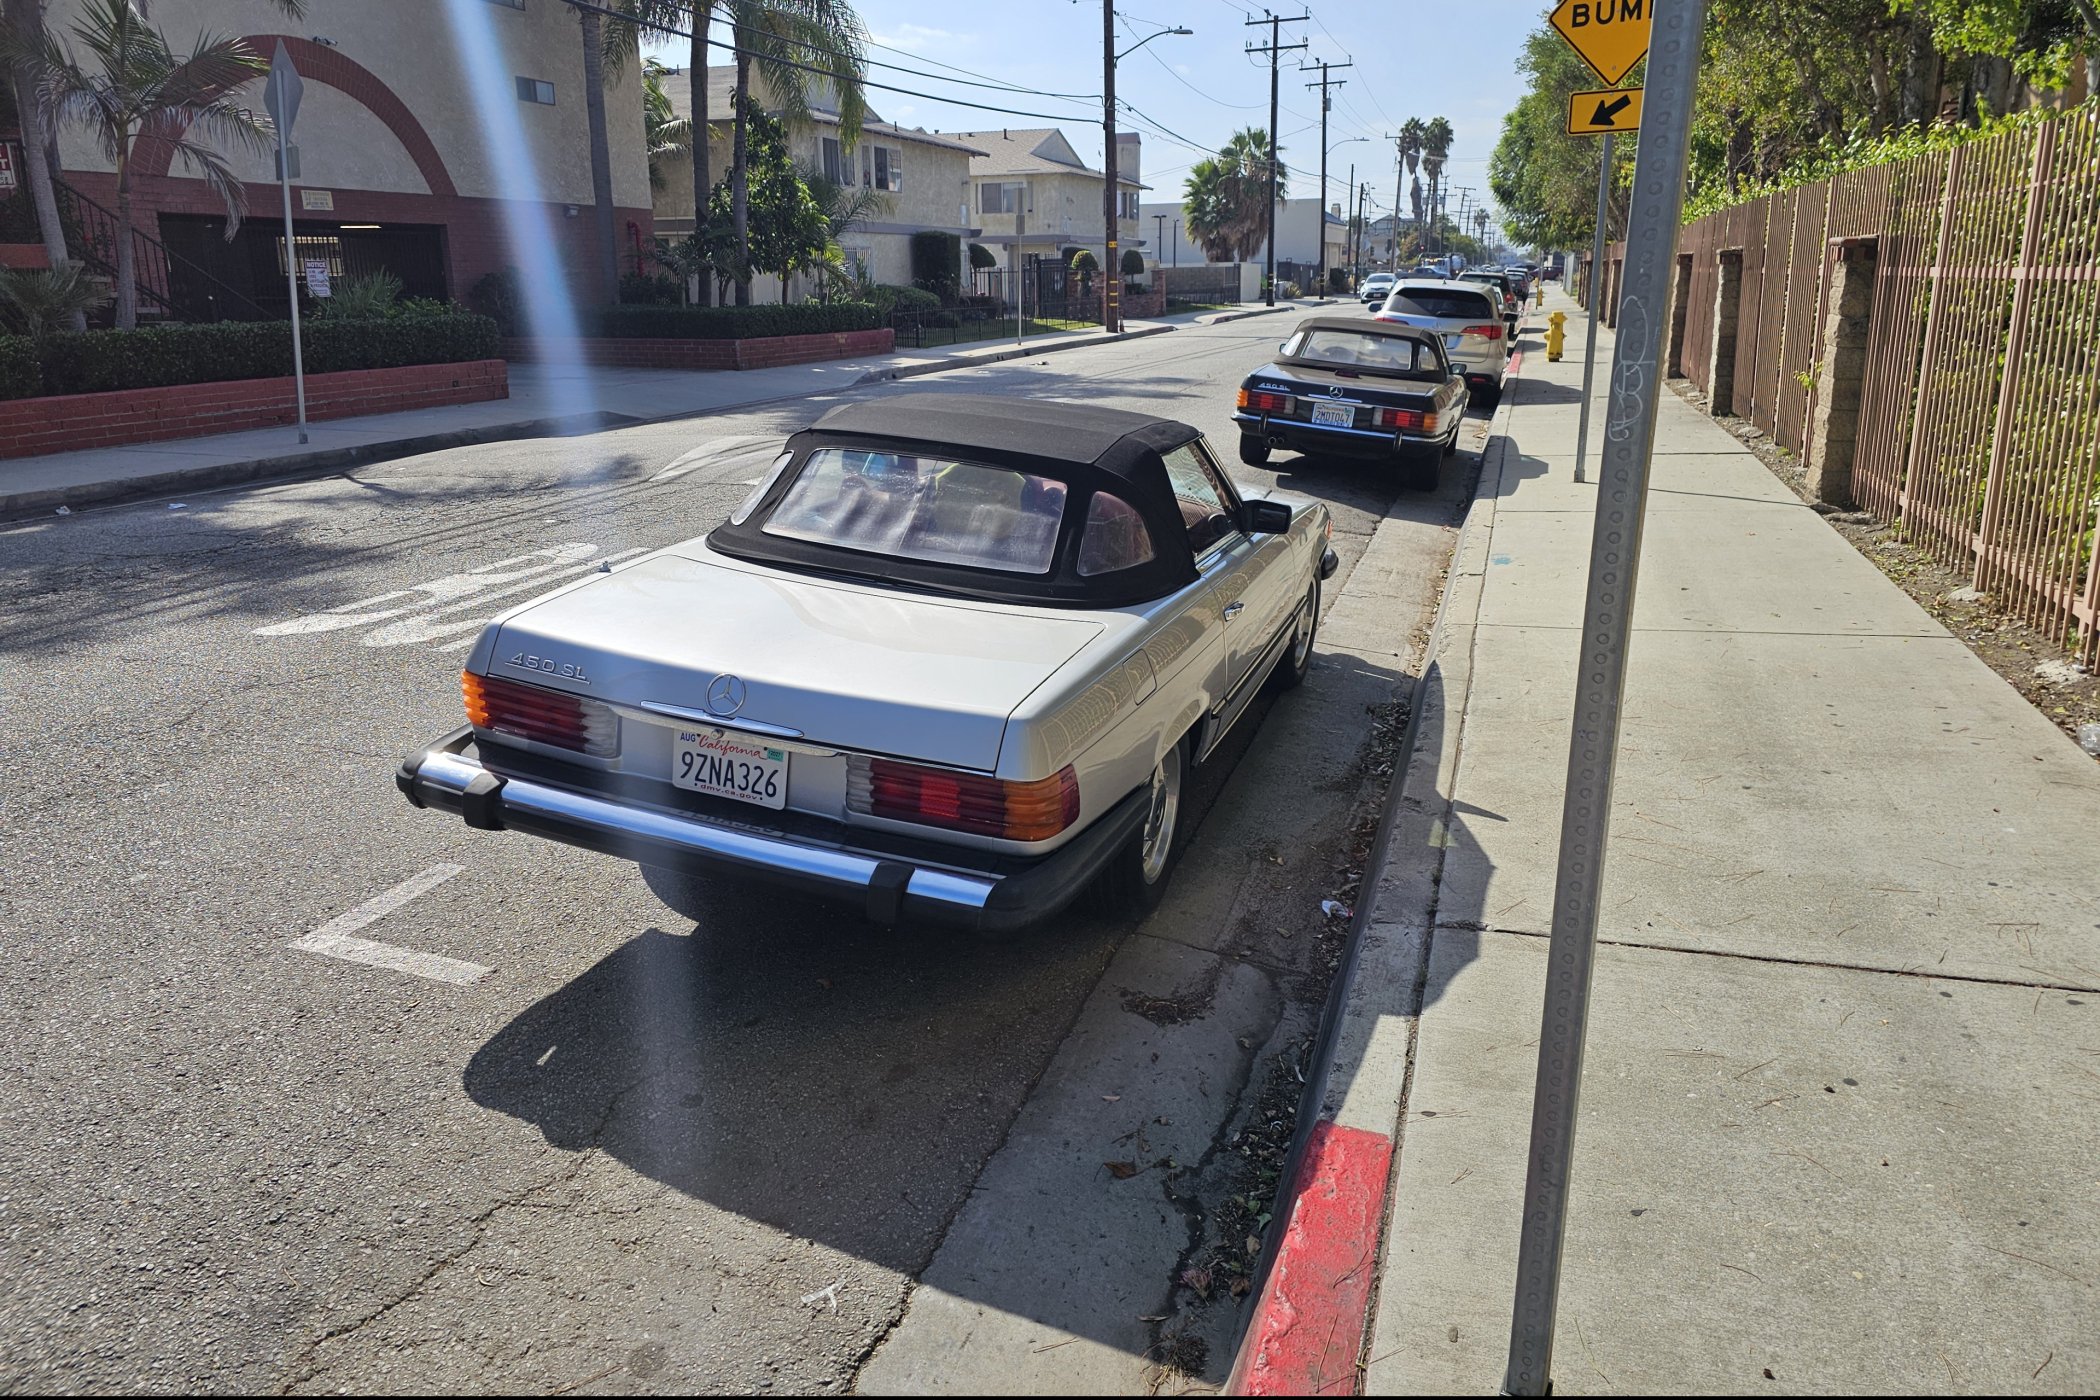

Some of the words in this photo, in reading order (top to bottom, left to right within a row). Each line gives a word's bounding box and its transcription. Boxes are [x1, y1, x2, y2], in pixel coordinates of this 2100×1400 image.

[511, 652, 556, 672] 450
[561, 663, 587, 680] SL
[680, 732, 696, 742] AUG
[699, 734, 768, 760] California
[680, 751, 779, 798] 9ZNA326
[700, 784, 758, 800] dmv.ca.gov
